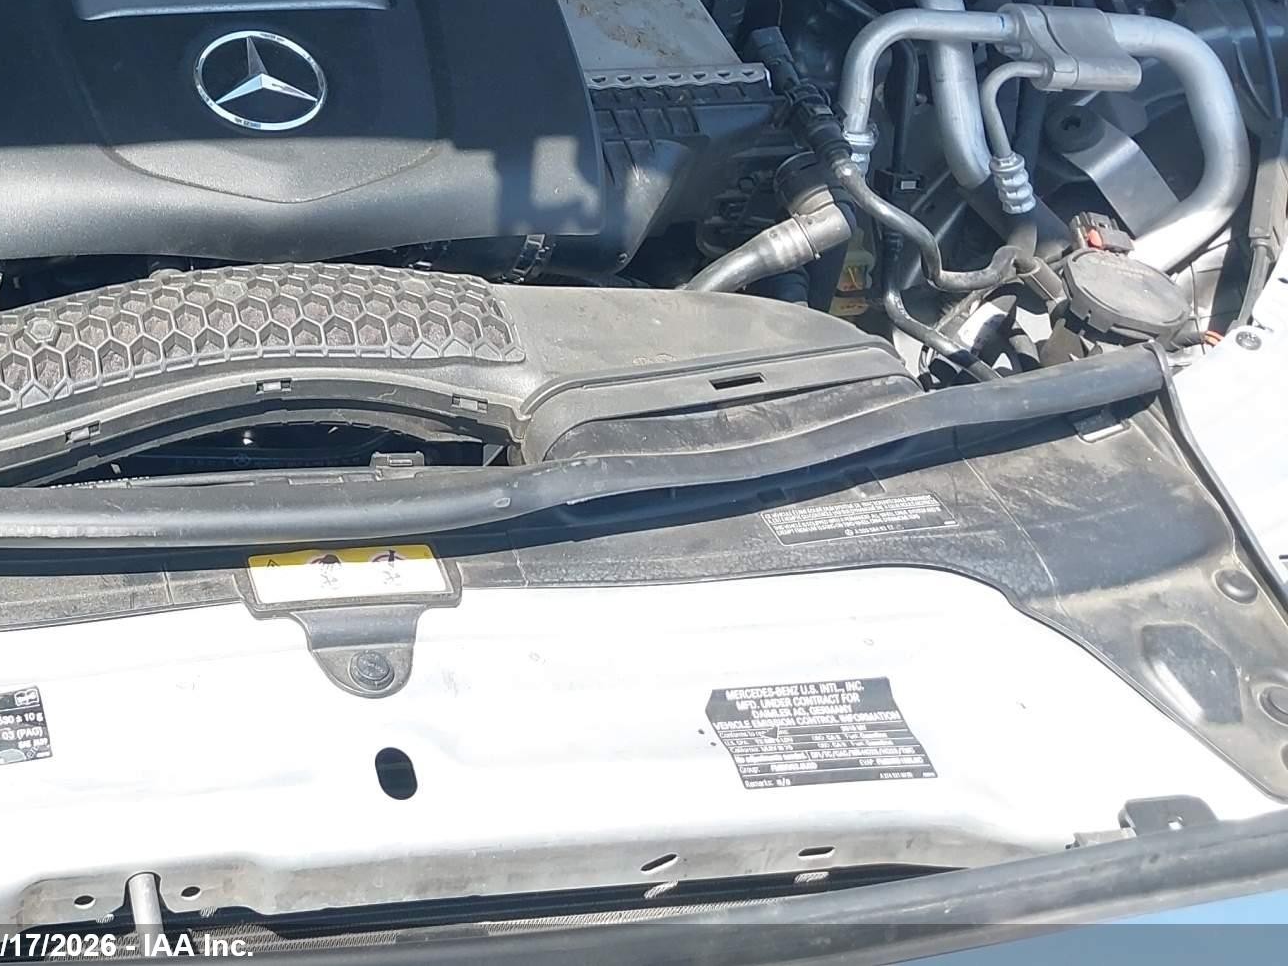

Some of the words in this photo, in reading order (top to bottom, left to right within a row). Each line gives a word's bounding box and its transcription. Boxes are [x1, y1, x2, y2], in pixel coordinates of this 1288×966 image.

[726, 686, 799, 700] MERCEDES-BENZ
[800, 684, 818, 694] U.S.
[845, 680, 864, 692] INC.
[760, 697, 792, 709] UNDER
[793, 694, 839, 707] CONTRACT
[840, 692, 860, 703] FOR
[24, 712, 35, 722] 10
[809, 704, 852, 716] GERMANY
[713, 720, 752, 731] VEHICLE
[796, 715, 839, 726] CONTROL
[839, 710, 901, 723] INFORMATION
